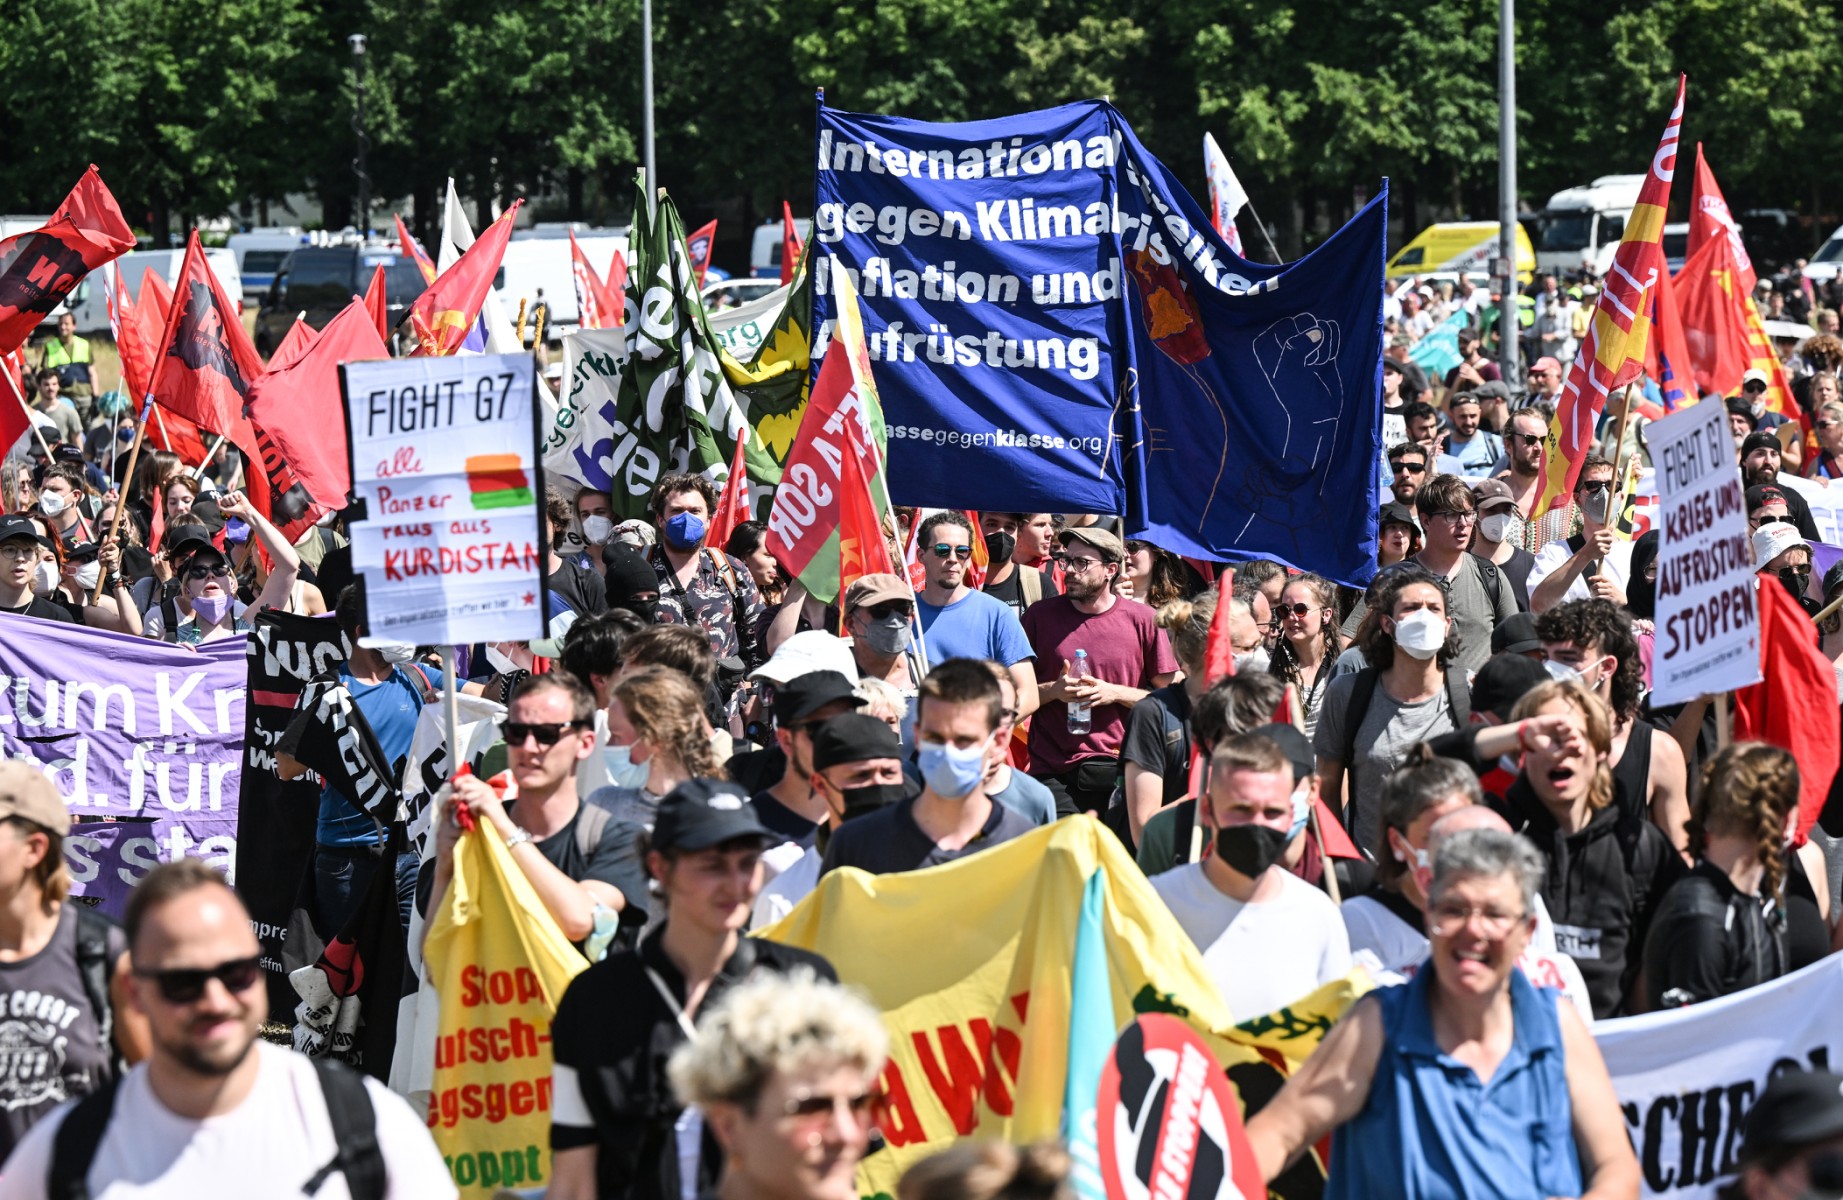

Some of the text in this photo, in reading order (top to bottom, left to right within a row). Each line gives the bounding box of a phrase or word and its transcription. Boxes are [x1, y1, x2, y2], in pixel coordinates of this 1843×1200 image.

[816, 202, 970, 246] gegen
[977, 192, 1179, 275] Klimaris
[1032, 257, 1121, 304] und
[368, 373, 516, 437] FIGHT G7
[376, 447, 424, 478] alle
[885, 424, 1101, 455] assegegenklasse.org
[1662, 415, 1725, 495] FIGHT G7
[377, 485, 452, 515] Panzer
[1666, 489, 1713, 545] KRIEG
[450, 520, 491, 536] aus
[384, 541, 541, 581] KURDISTAN
[1659, 535, 1750, 600] AUFRÜSTUN
[1663, 580, 1754, 660] STOPPEN
[123, 739, 239, 812] für
[435, 1017, 553, 1070] utsch-
